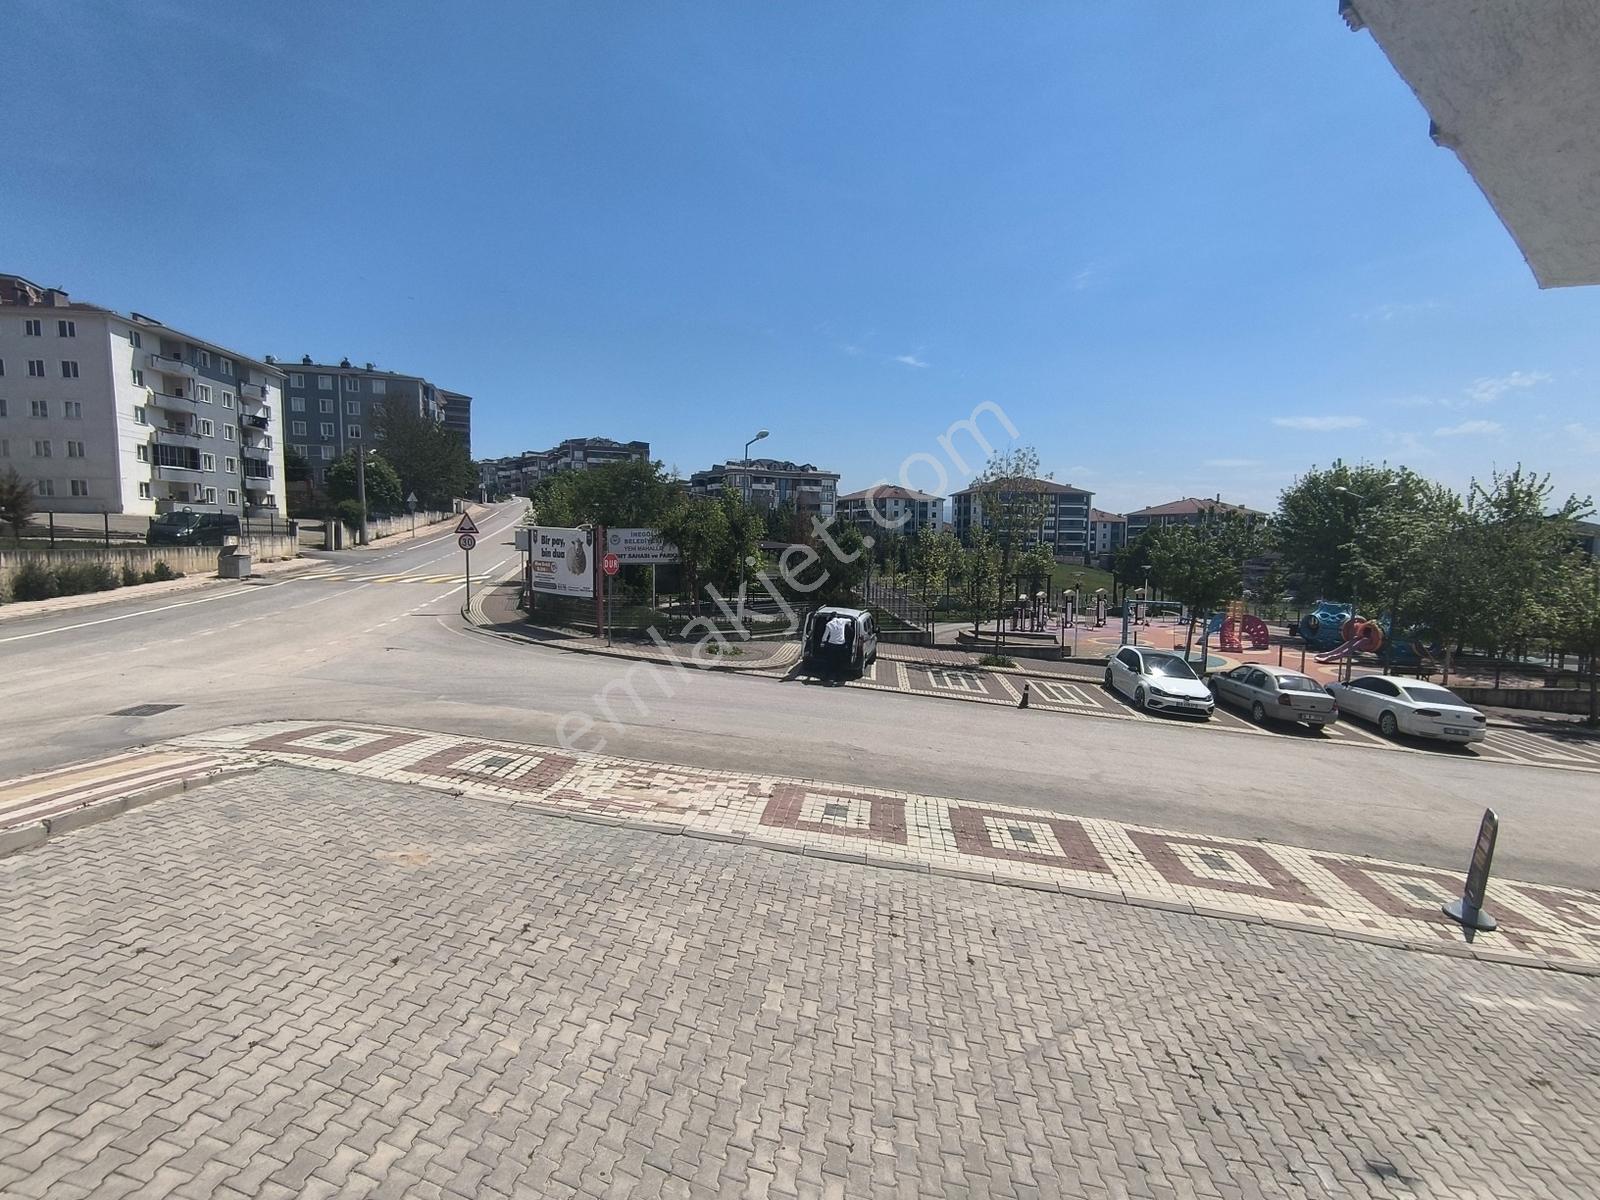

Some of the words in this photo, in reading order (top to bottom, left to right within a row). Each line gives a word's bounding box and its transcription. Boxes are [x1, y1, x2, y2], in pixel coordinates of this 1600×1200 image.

[462, 538, 473, 546] 30
[541, 535, 551, 545] Bir
[552, 538, 565, 547] pay,
[541, 547, 551, 557] bin
[552, 548, 565, 558] dua
[604, 559, 617, 568] DUR
